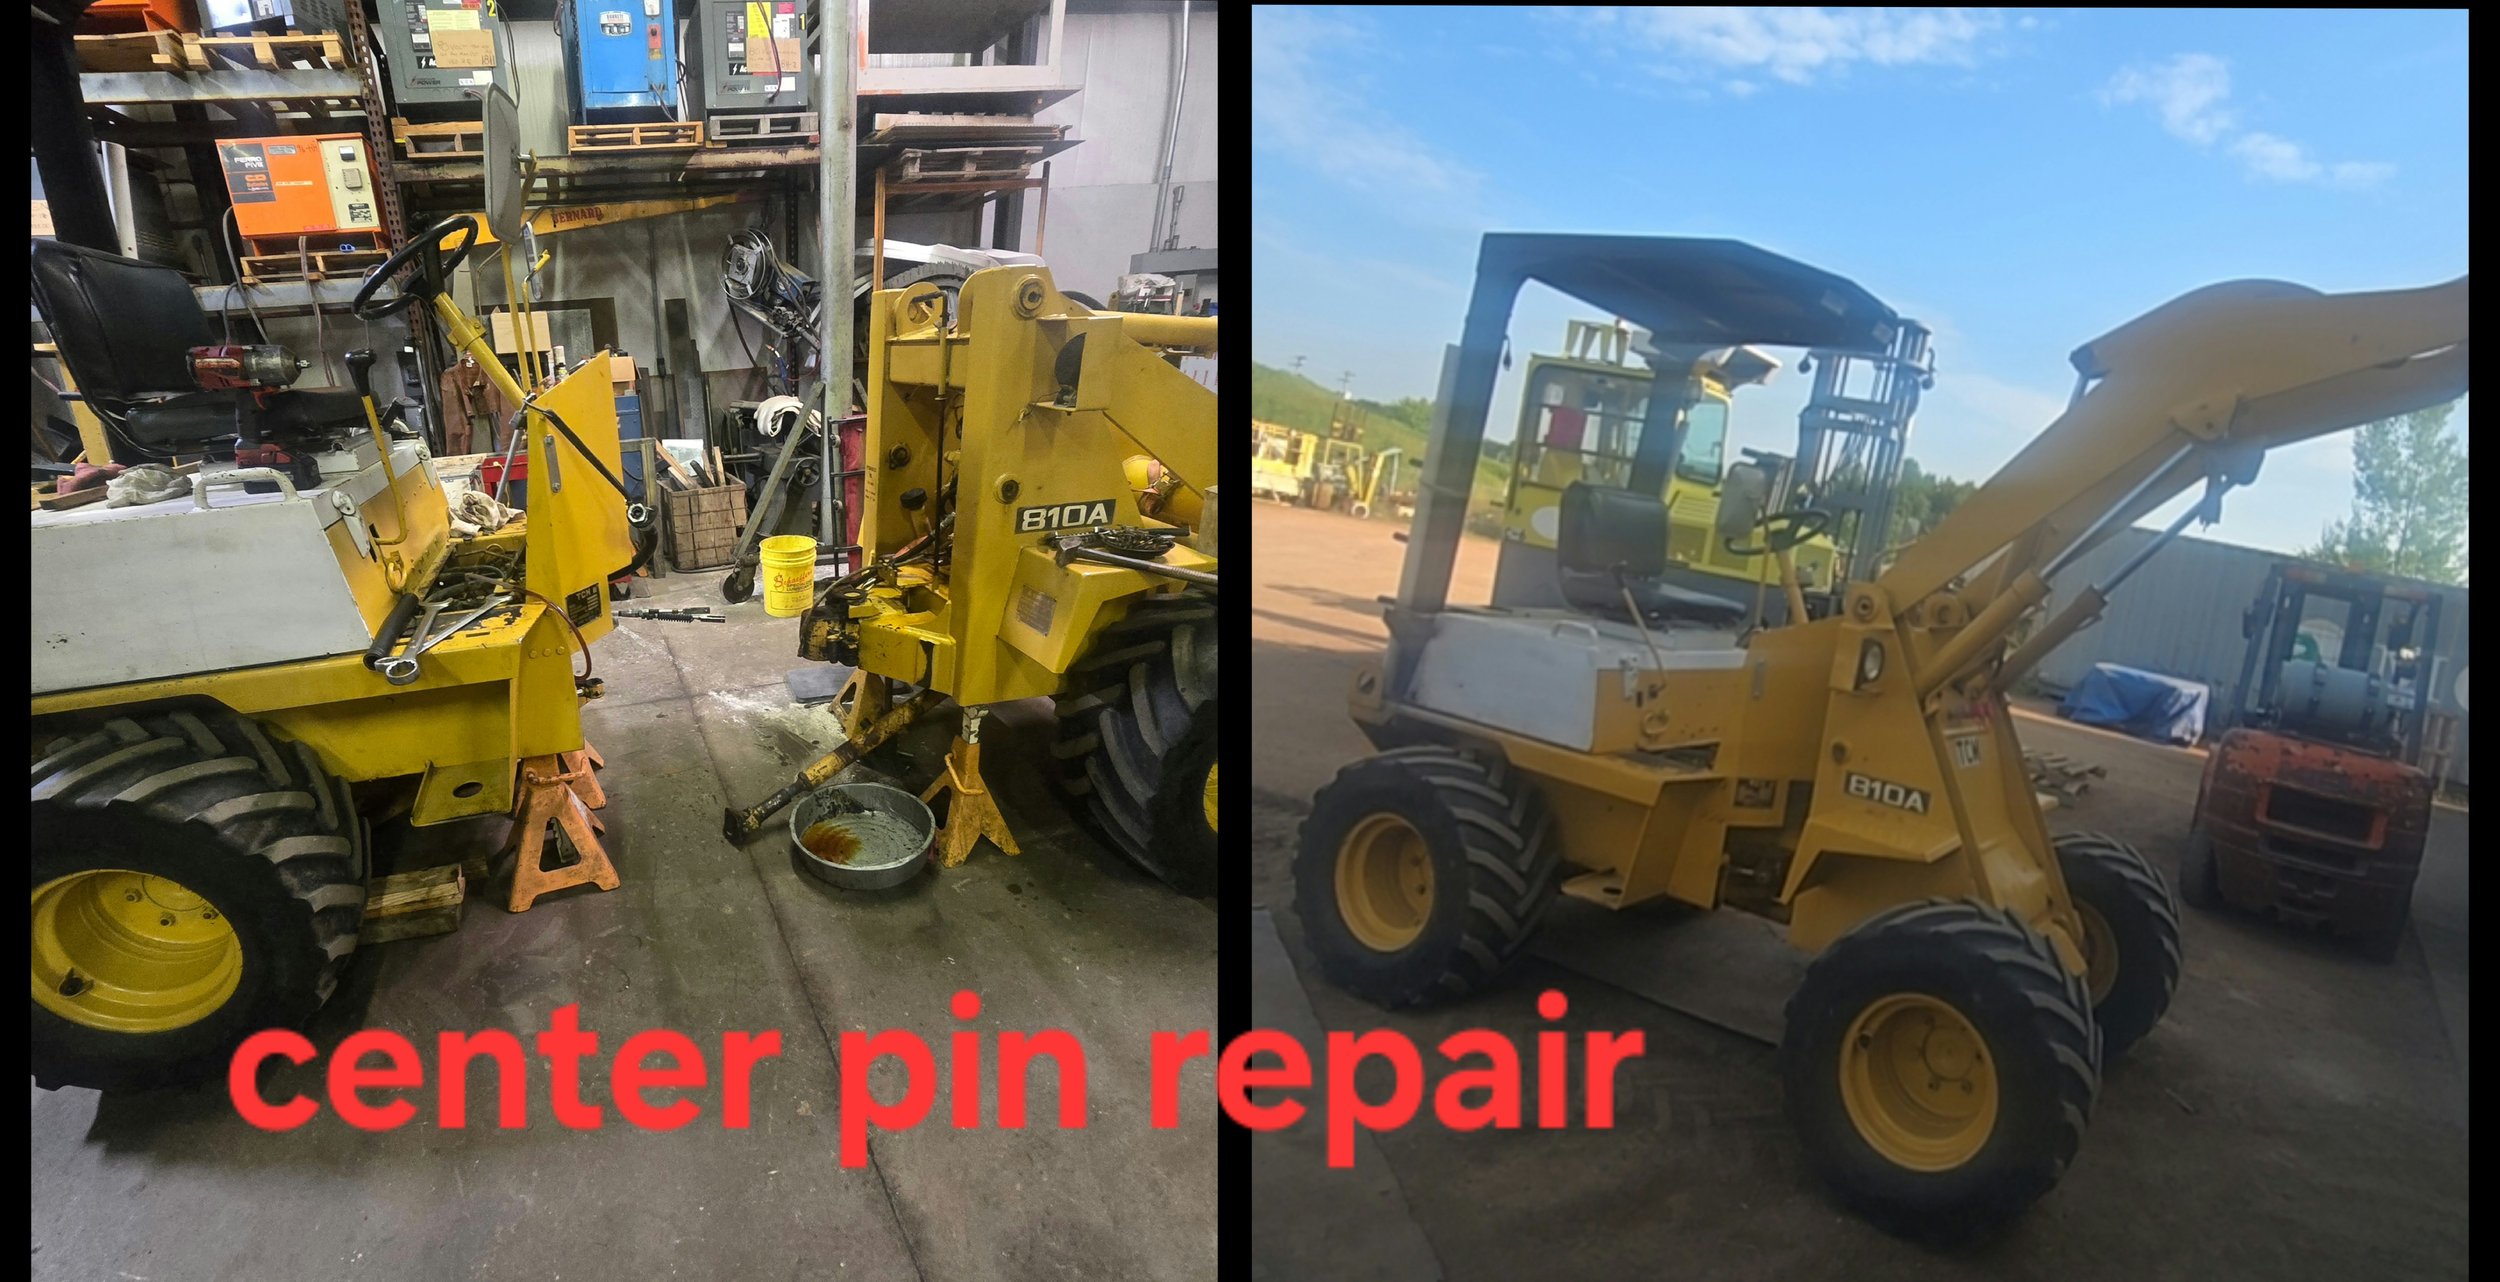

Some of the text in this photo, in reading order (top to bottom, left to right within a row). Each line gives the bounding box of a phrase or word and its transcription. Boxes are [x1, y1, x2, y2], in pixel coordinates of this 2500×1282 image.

[486, 0, 496, 16] 2
[800, 13, 806, 31] 1
[551, 206, 604, 224] BERNARD
[1022, 503, 1108, 531] 810A
[1849, 774, 1924, 813] 810A
